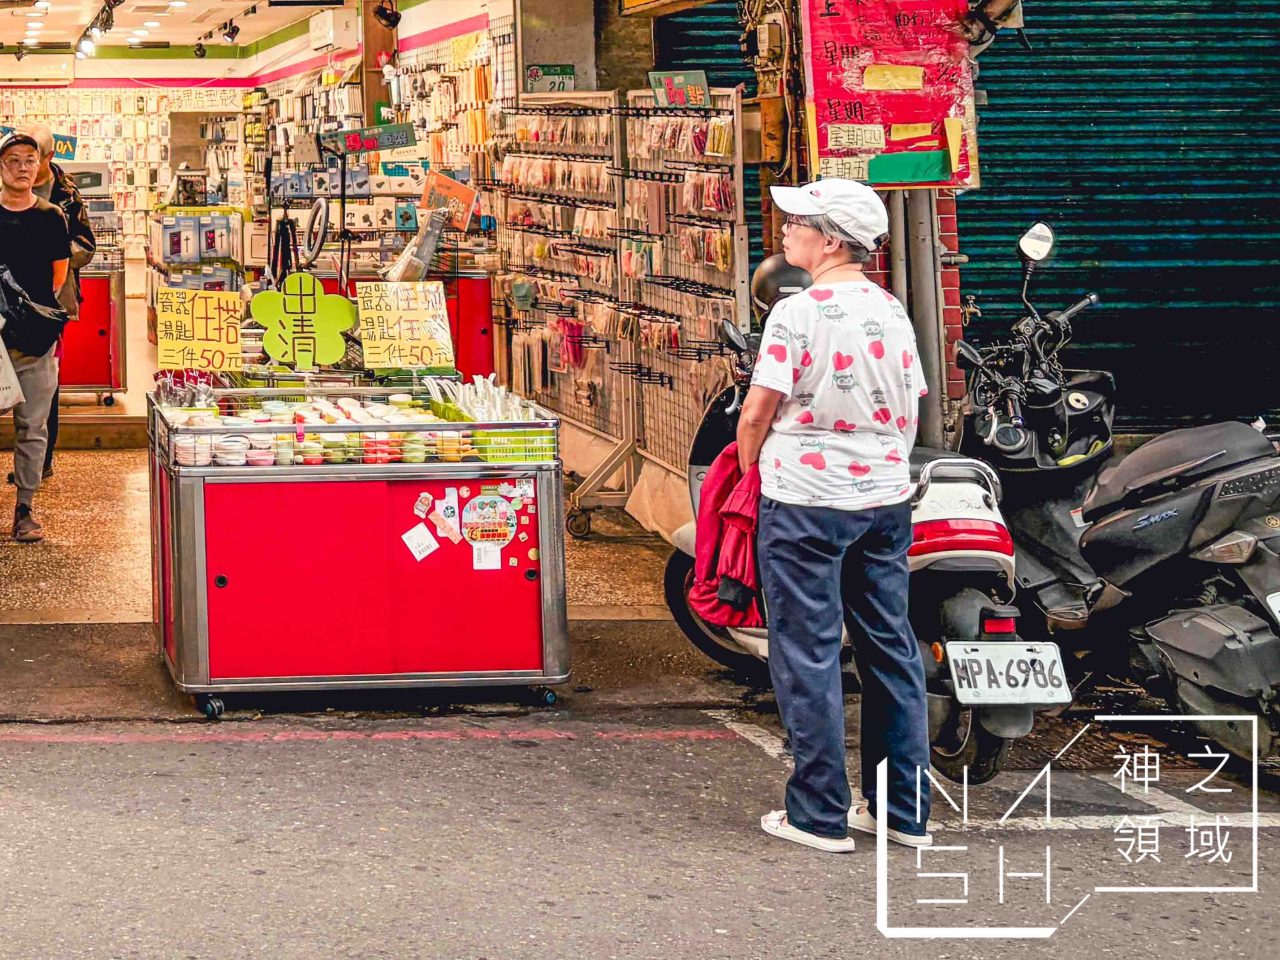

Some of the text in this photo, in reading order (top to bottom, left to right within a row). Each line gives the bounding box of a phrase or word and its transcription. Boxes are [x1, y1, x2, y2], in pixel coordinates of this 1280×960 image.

[278, 275, 317, 363] 出清
[160, 345, 242, 369] 三件50元
[366, 344, 454, 367] 三件50元
